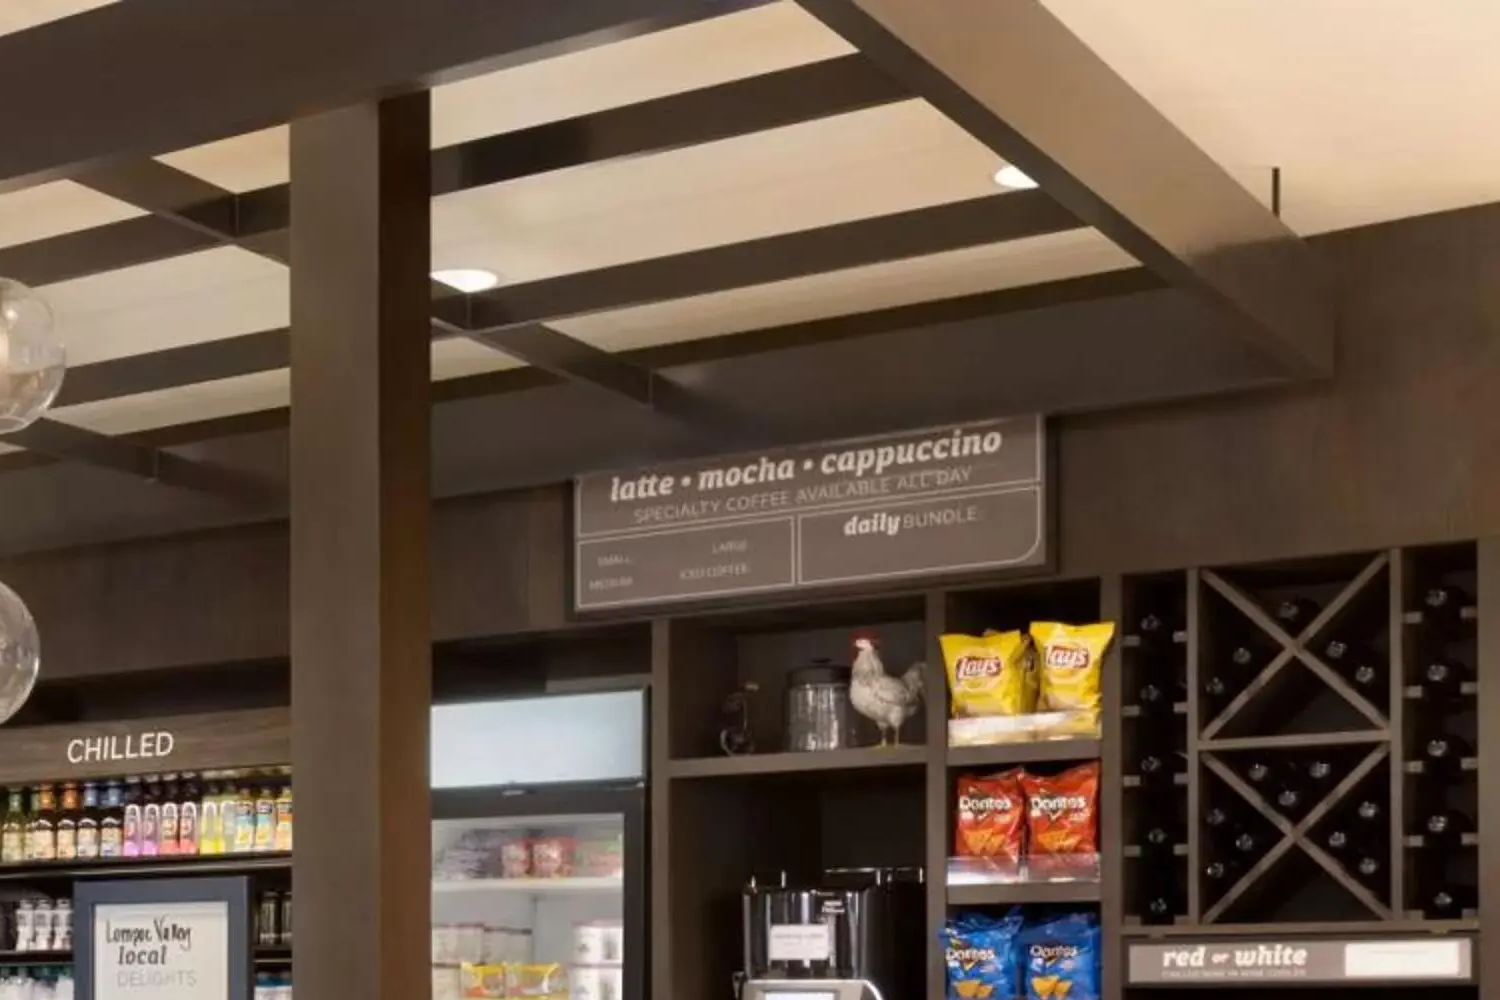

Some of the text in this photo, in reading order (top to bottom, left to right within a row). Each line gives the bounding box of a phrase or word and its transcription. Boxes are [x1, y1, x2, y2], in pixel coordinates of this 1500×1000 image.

[610, 429, 1003, 502] latte mocha cappuccino
[633, 465, 973, 523] SPECIALTY COFFEE AVAILABLE ALL DAY
[844, 506, 978, 535] daily BUNDLE
[67, 731, 174, 764] CHILLED
[118, 945, 167, 965] local
[1163, 944, 1308, 967] red or white
[116, 969, 198, 988] DELIGHTS
